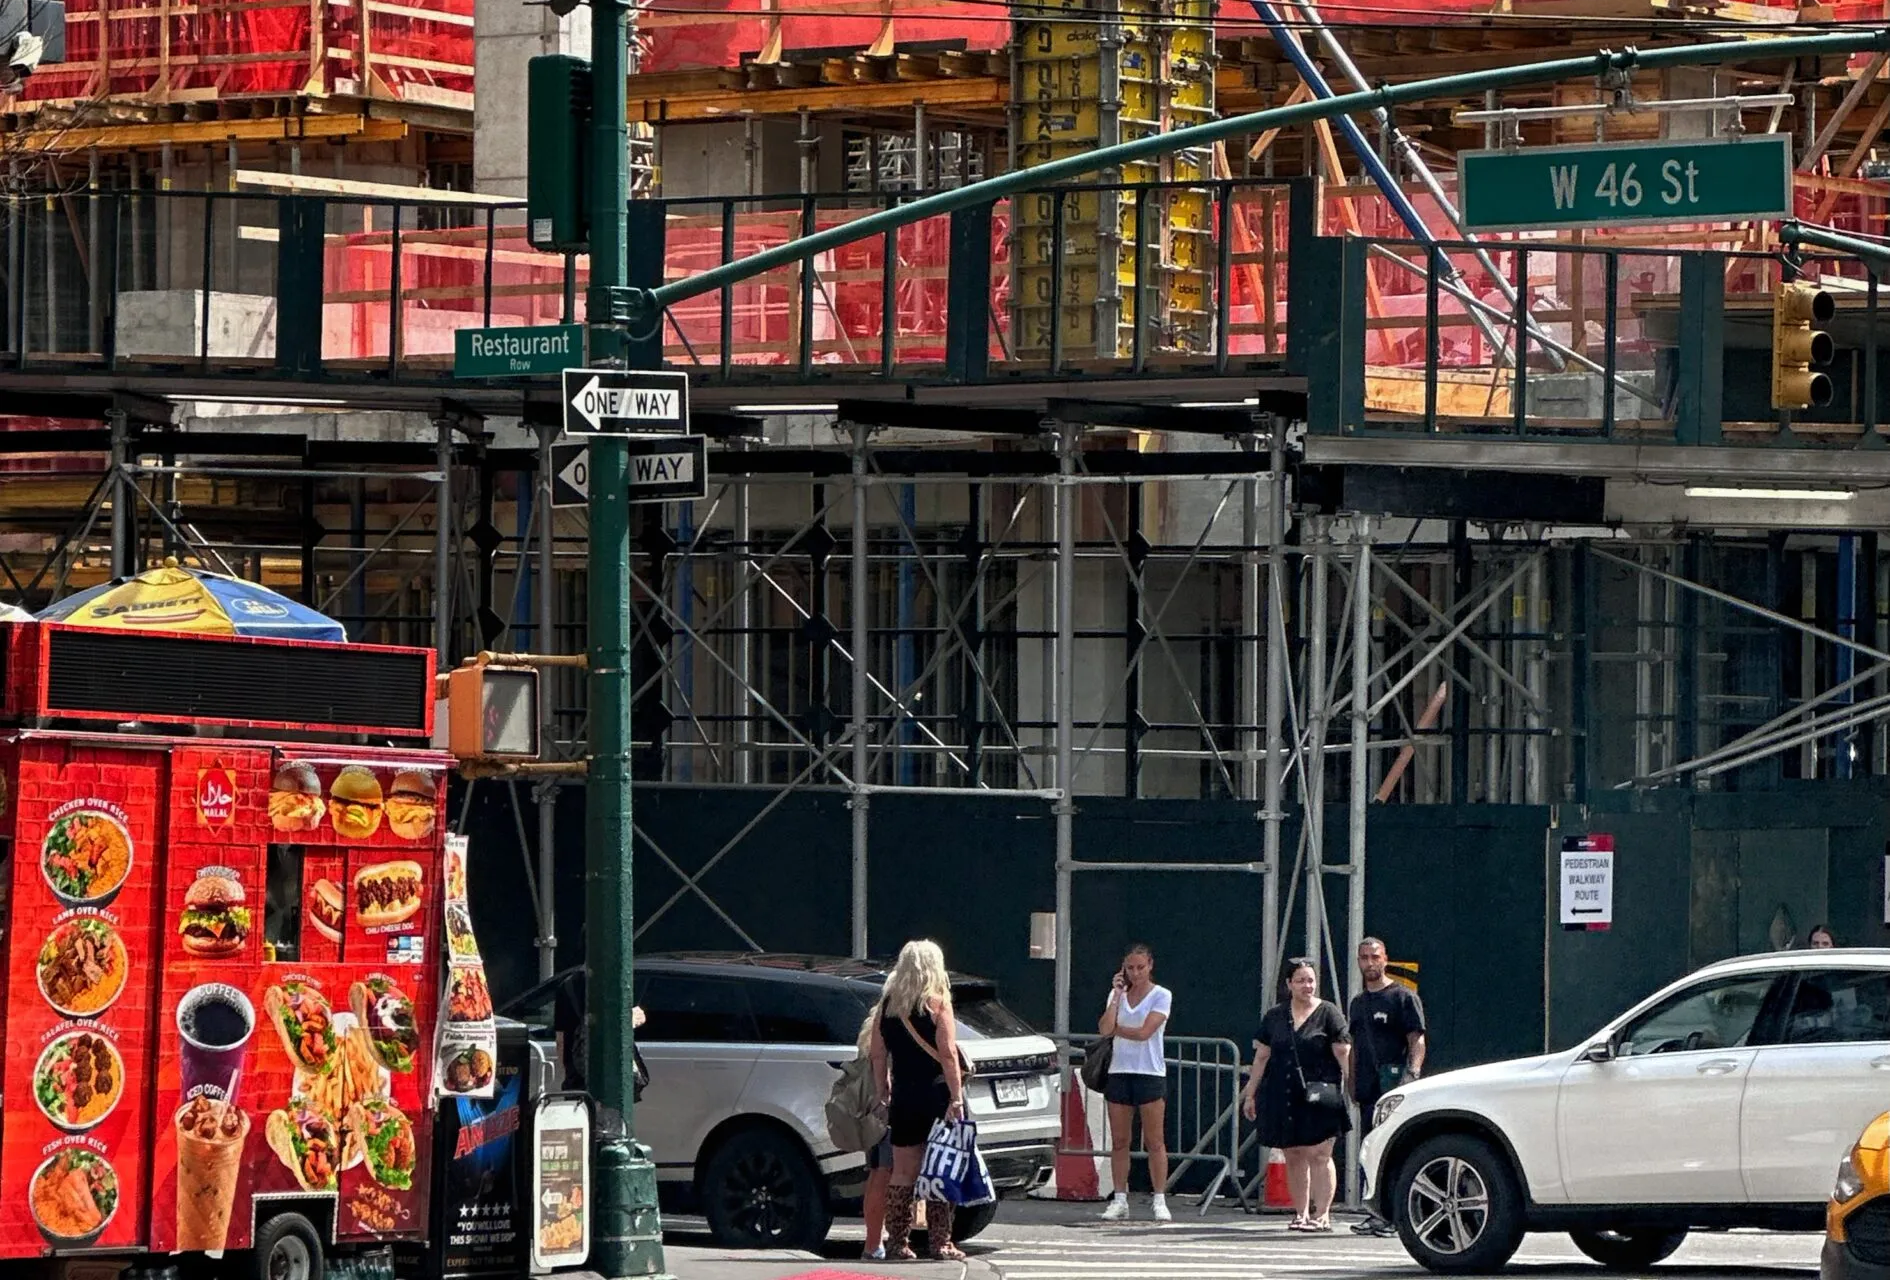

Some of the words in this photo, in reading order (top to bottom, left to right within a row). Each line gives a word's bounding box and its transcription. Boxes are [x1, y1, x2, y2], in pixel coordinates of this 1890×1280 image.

[1550, 165, 1578, 210] W
[1595, 162, 1643, 207] 46
[1661, 159, 1700, 205] St
[471, 330, 570, 357] Restaurant
[510, 358, 531, 371] Row
[584, 391, 620, 415] ONE
[636, 393, 671, 417] WAY
[636, 456, 684, 482] WAY
[48, 798, 85, 822] CHICKEN
[87, 798, 109, 810] OVER
[109, 804, 129, 823] RICE
[203, 808, 229, 818] HALAL
[1564, 858, 1610, 869] PEDESTRIAN
[1568, 874, 1606, 885] WALKWAY
[1574, 889, 1600, 901] ROUTE
[52, 908, 75, 925] LAMB
[76, 907, 98, 916] OVER
[99, 908, 119, 924] RICE
[365, 926, 380, 935] CHILI
[380, 924, 401, 933] CHEESE
[402, 922, 414, 930] DOG
[200, 984, 238, 1000] COFFEE
[40, 1019, 75, 1043] FALAFEL
[76, 1018, 98, 1029] OVER
[99, 1022, 120, 1042] RICE
[186, 1084, 204, 1100] ICED
[42, 1138, 63, 1156] FISH
[64, 1135, 86, 1145] OVER
[87, 1136, 107, 1154] RICE
